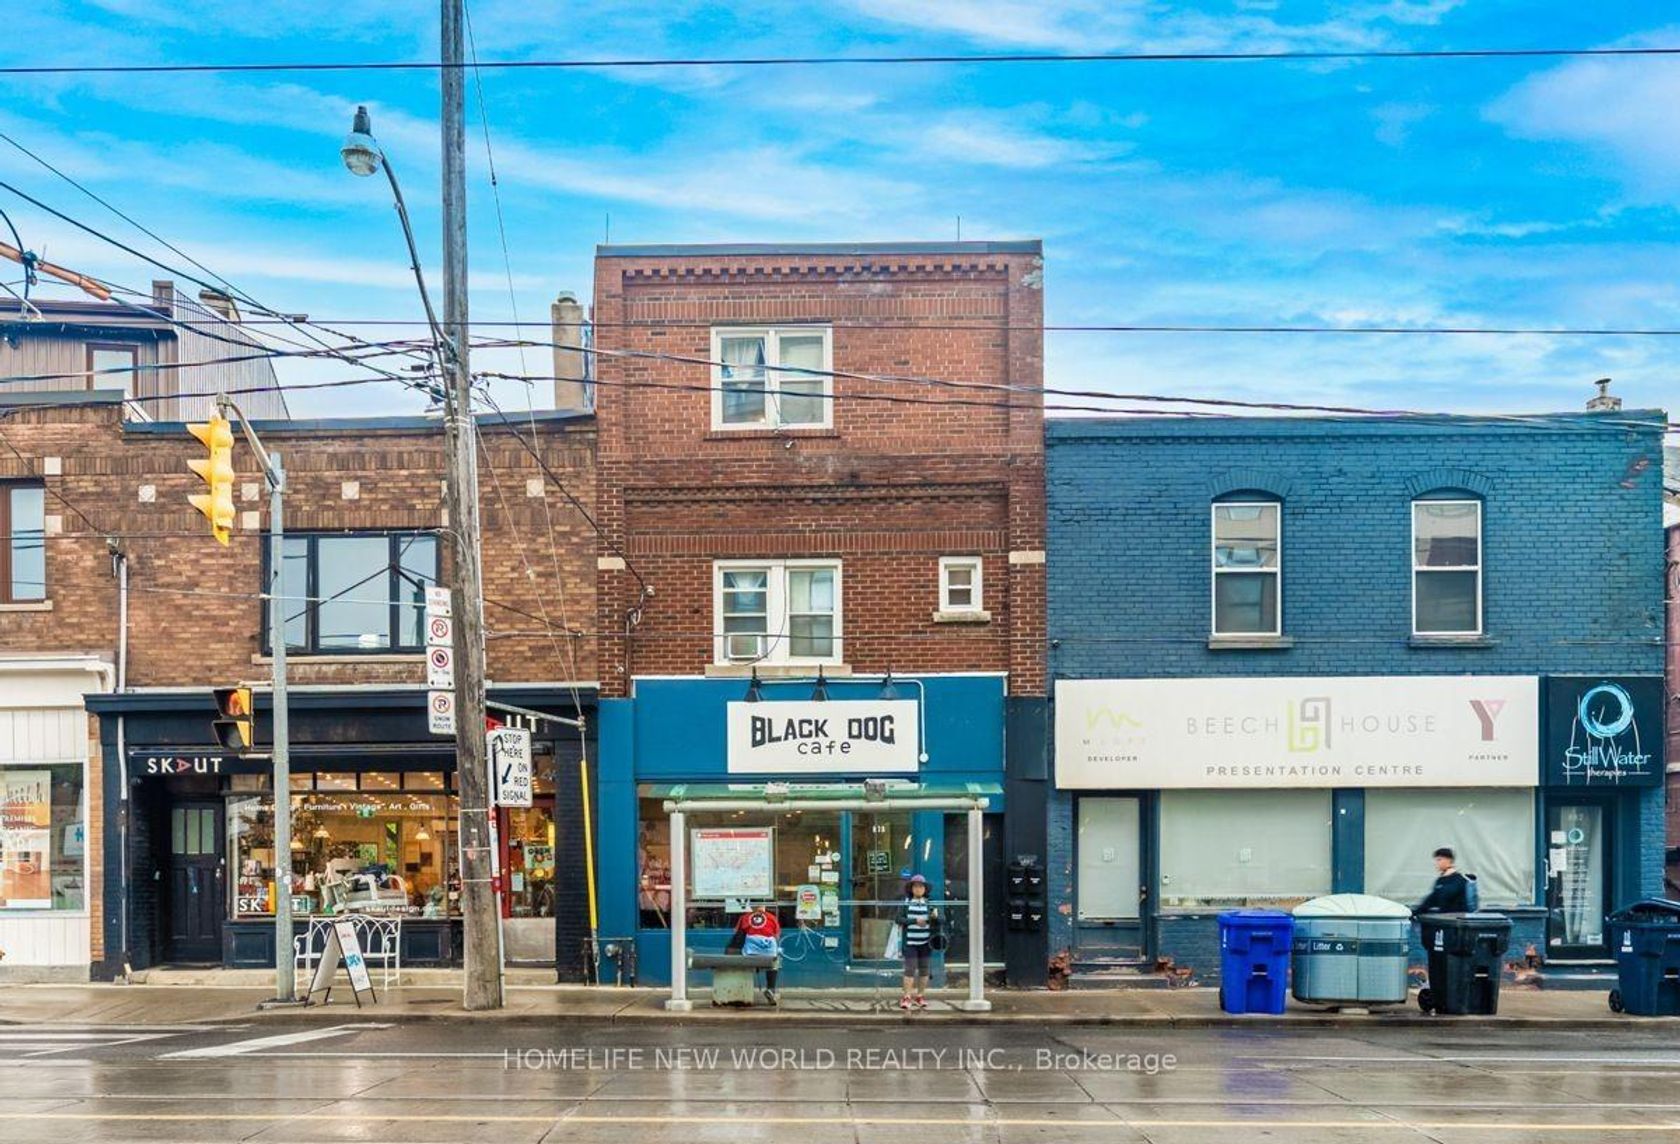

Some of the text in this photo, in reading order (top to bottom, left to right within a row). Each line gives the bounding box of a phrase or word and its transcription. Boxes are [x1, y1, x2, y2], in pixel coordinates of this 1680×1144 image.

[1186, 715, 1436, 735] BEECH HOUSE
[751, 714, 895, 748] BLACK DOG
[503, 733, 522, 744] STOP
[504, 747, 523, 758] HERE
[797, 740, 852, 755] cafe
[518, 762, 528, 773] ON
[1206, 765, 1424, 776] PRESENTATION CENTRE
[514, 776, 528, 787] RED
[502, 789, 528, 801] SIGNAL
[389, 803, 402, 811] Art
[1312, 942, 1331, 951] Litter
